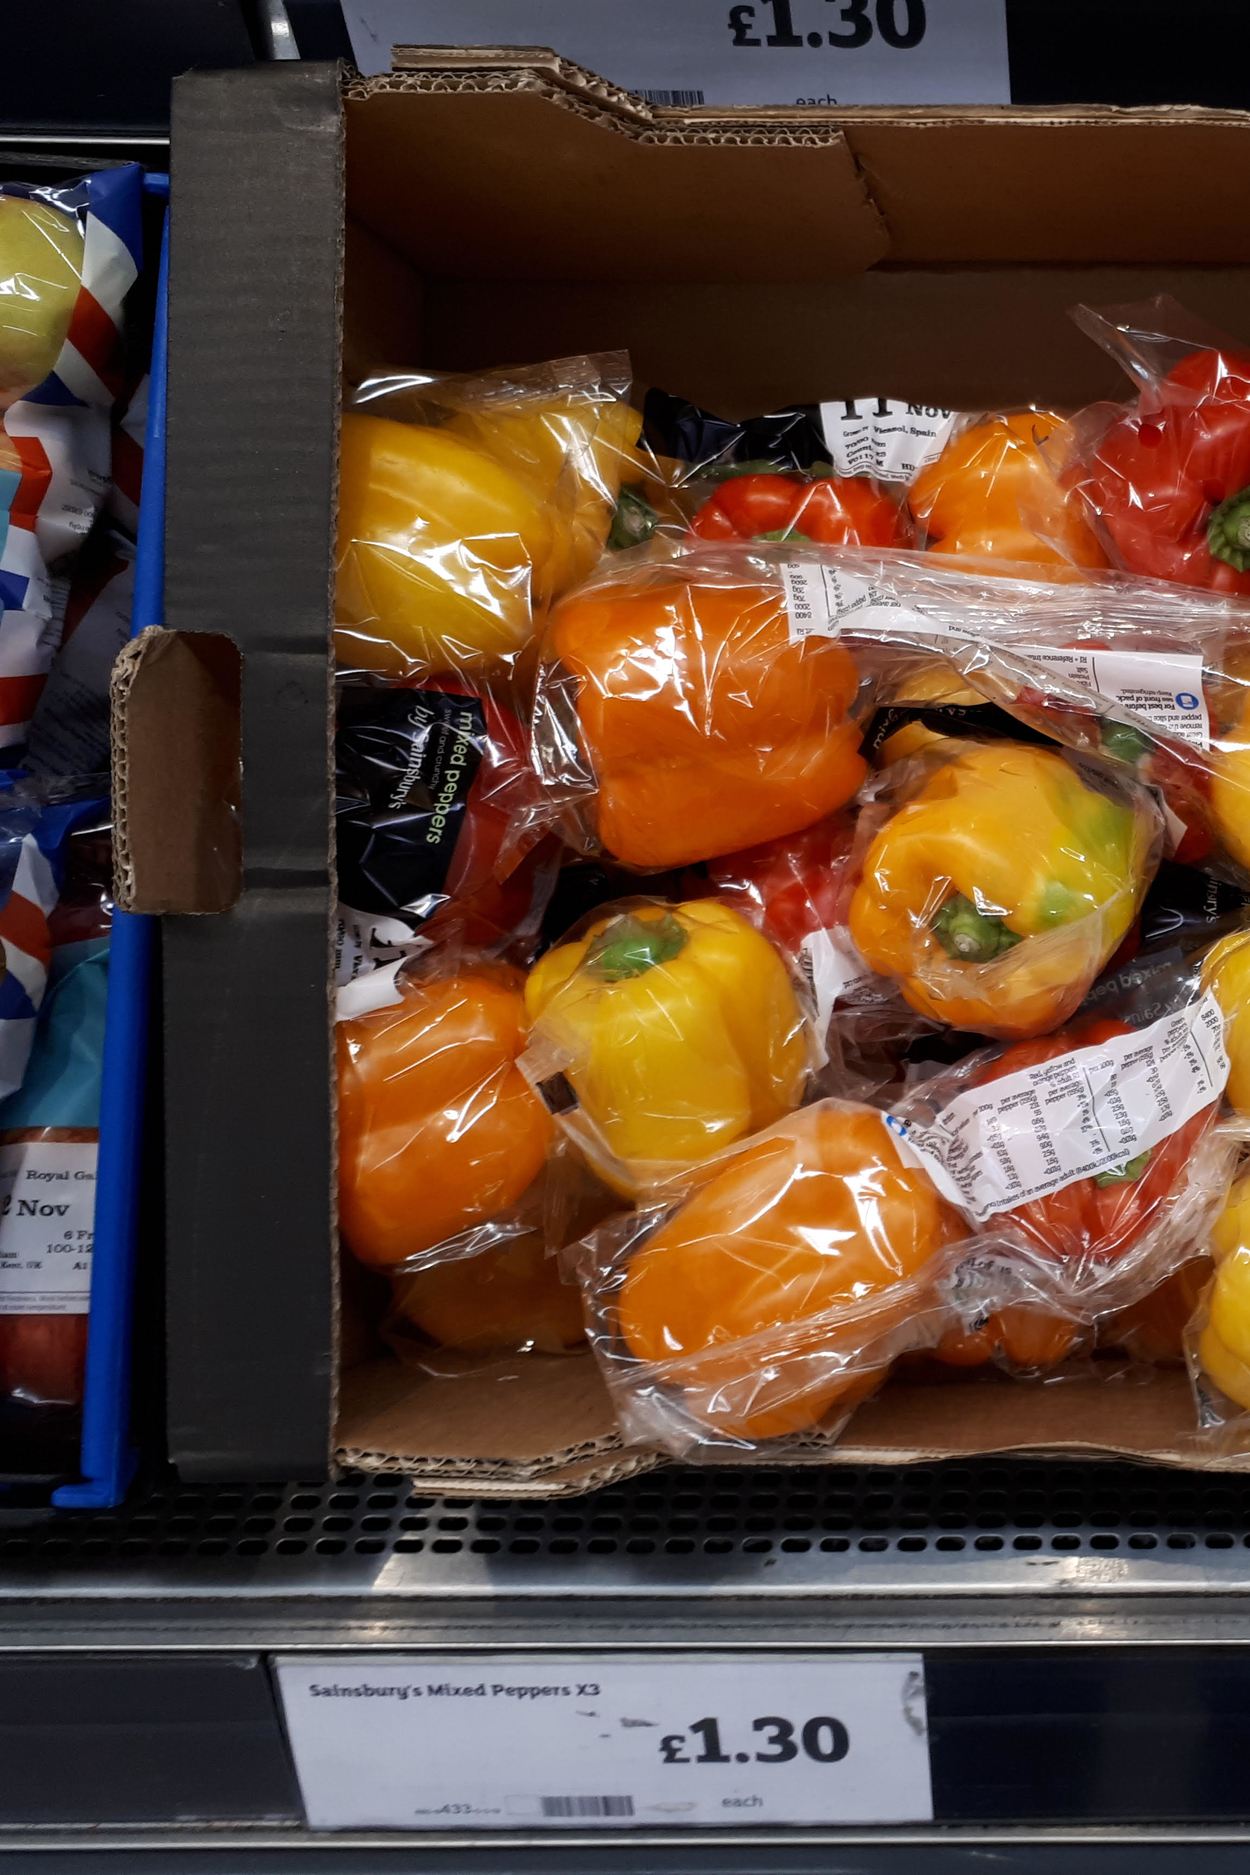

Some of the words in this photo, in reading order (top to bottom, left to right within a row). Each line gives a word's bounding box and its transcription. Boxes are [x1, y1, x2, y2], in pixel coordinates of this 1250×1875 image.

[728, 0, 926, 49] £1.30
[910, 427, 937, 437] Spain
[408, 705, 435, 730] by
[437, 736, 447, 755] and
[450, 711, 475, 767] mixed
[388, 731, 430, 810] Sainsbury's
[428, 756, 443, 791] crunchy
[426, 770, 460, 844] peppers
[1064, 1058, 1076, 1066] and
[1012, 1089, 1036, 1102] average
[1045, 1093, 1066, 1105] pepper
[26, 1170, 69, 1183] Royal
[74, 1171, 95, 1180] Ga
[1034, 1179, 1059, 1194] average
[16, 1199, 70, 1217] Nov
[46, 1244, 93, 1254] 100-12
[309, 1683, 422, 1700] Sainsbury's
[427, 1682, 486, 1697] Mixed
[491, 1684, 570, 1700] Peppers
[575, 1683, 600, 1696] X3
[658, 1715, 850, 1764] £1.30
[721, 1794, 764, 1808] each
